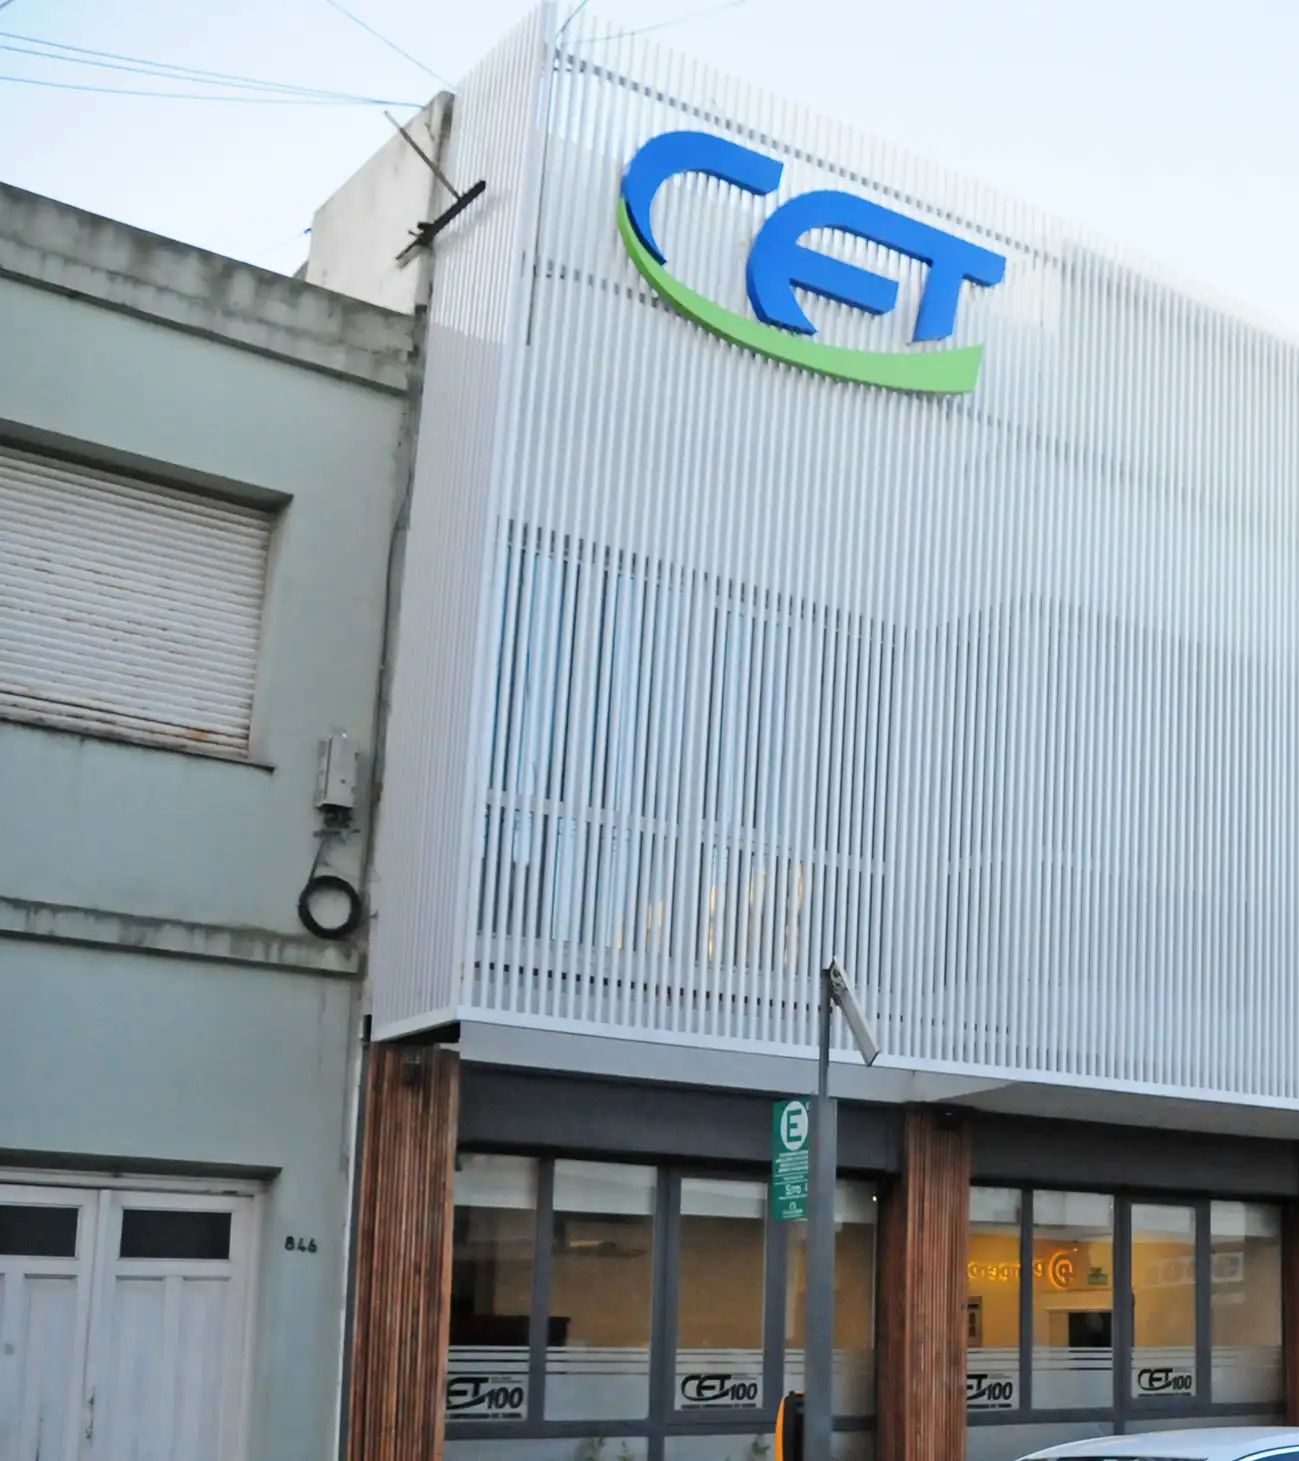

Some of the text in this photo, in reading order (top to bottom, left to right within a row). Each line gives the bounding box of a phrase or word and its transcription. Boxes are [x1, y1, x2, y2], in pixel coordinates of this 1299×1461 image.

[621, 130, 1007, 350] CET
[787, 1108, 802, 1142] E
[285, 1235, 318, 1253] 846
[446, 1376, 524, 1410] ET 100
[681, 1374, 758, 1401] CET 100
[987, 1382, 1013, 1401] 100
[1138, 1368, 1192, 1391] CET 100
